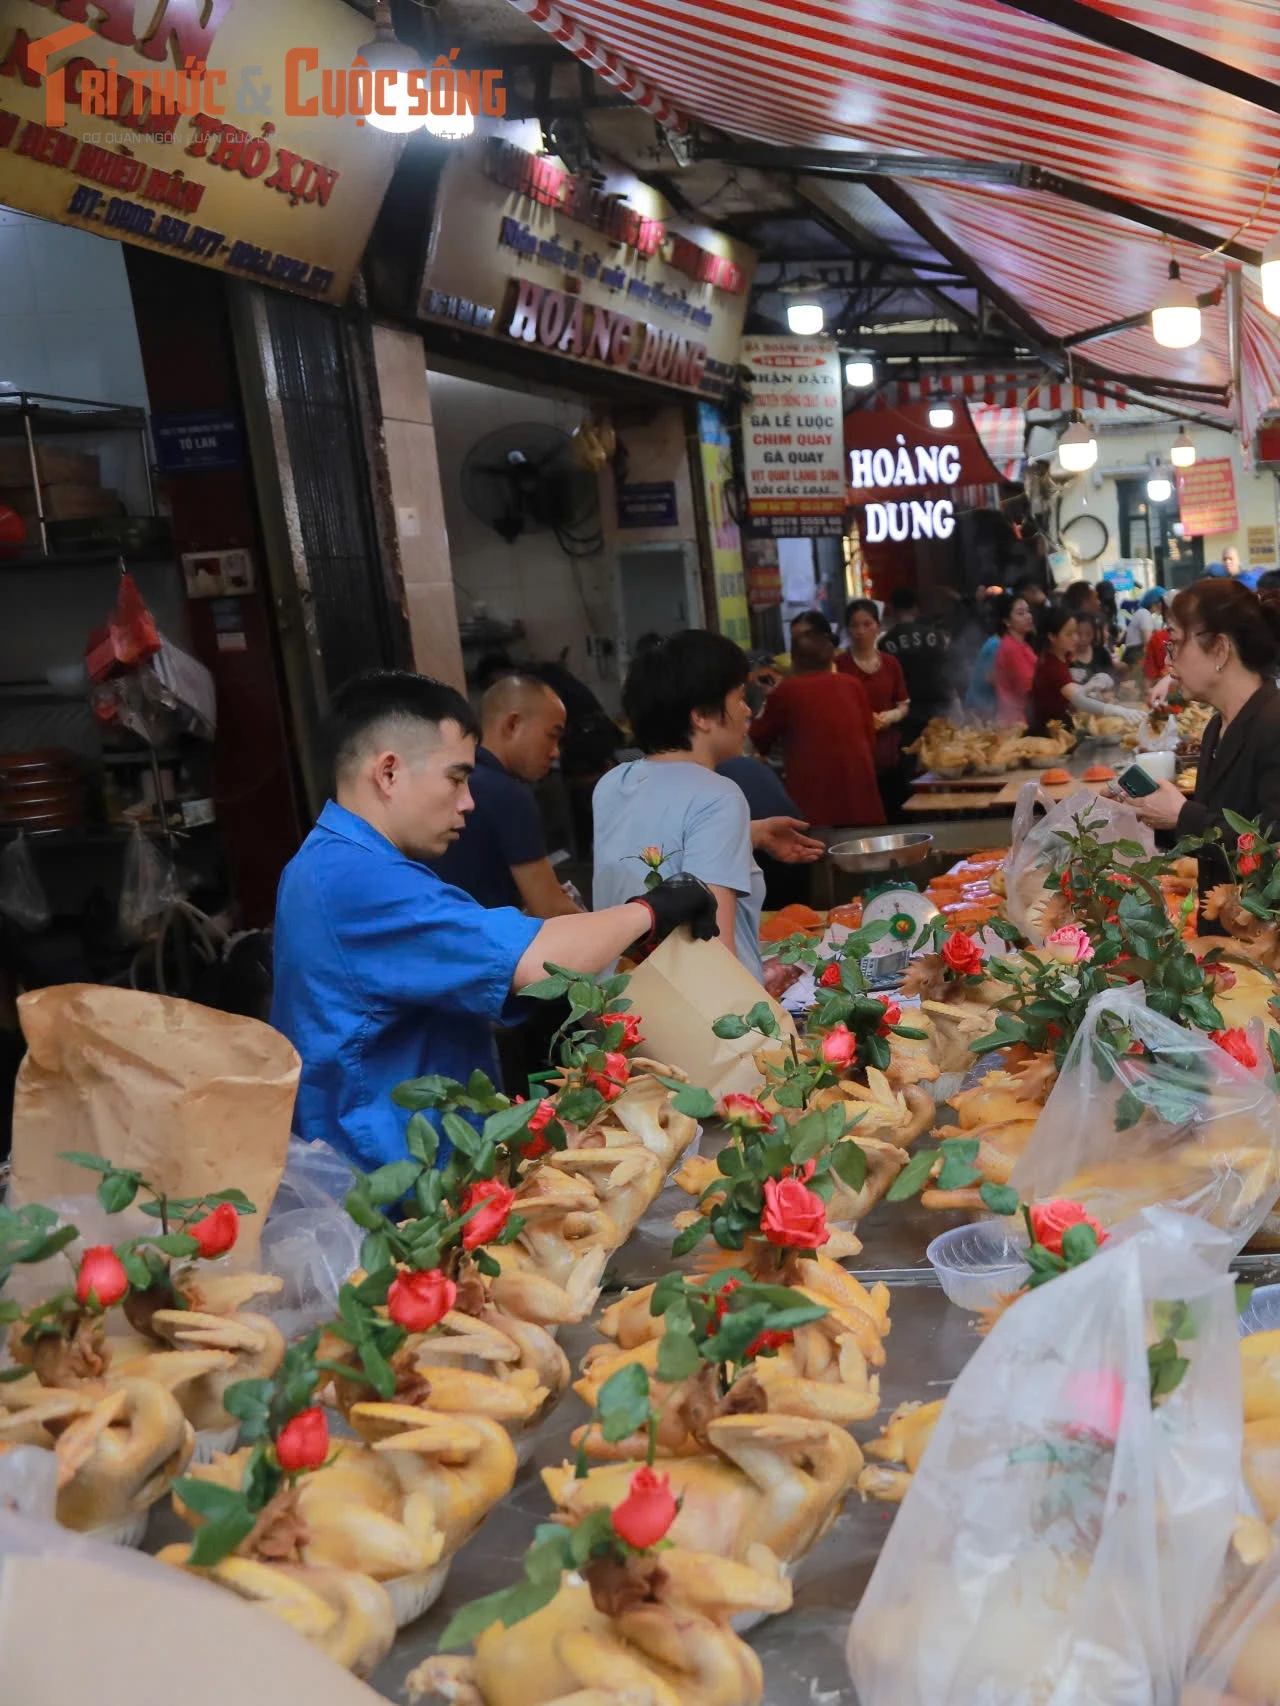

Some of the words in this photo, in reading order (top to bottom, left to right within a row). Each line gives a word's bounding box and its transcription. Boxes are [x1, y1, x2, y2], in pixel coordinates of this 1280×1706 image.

[752, 432, 793, 446] CHIM
[796, 432, 832, 447] QUAY
[788, 450, 825, 464] QUAY
[849, 433, 962, 489] HOÀNG
[864, 499, 956, 543] DUNG
